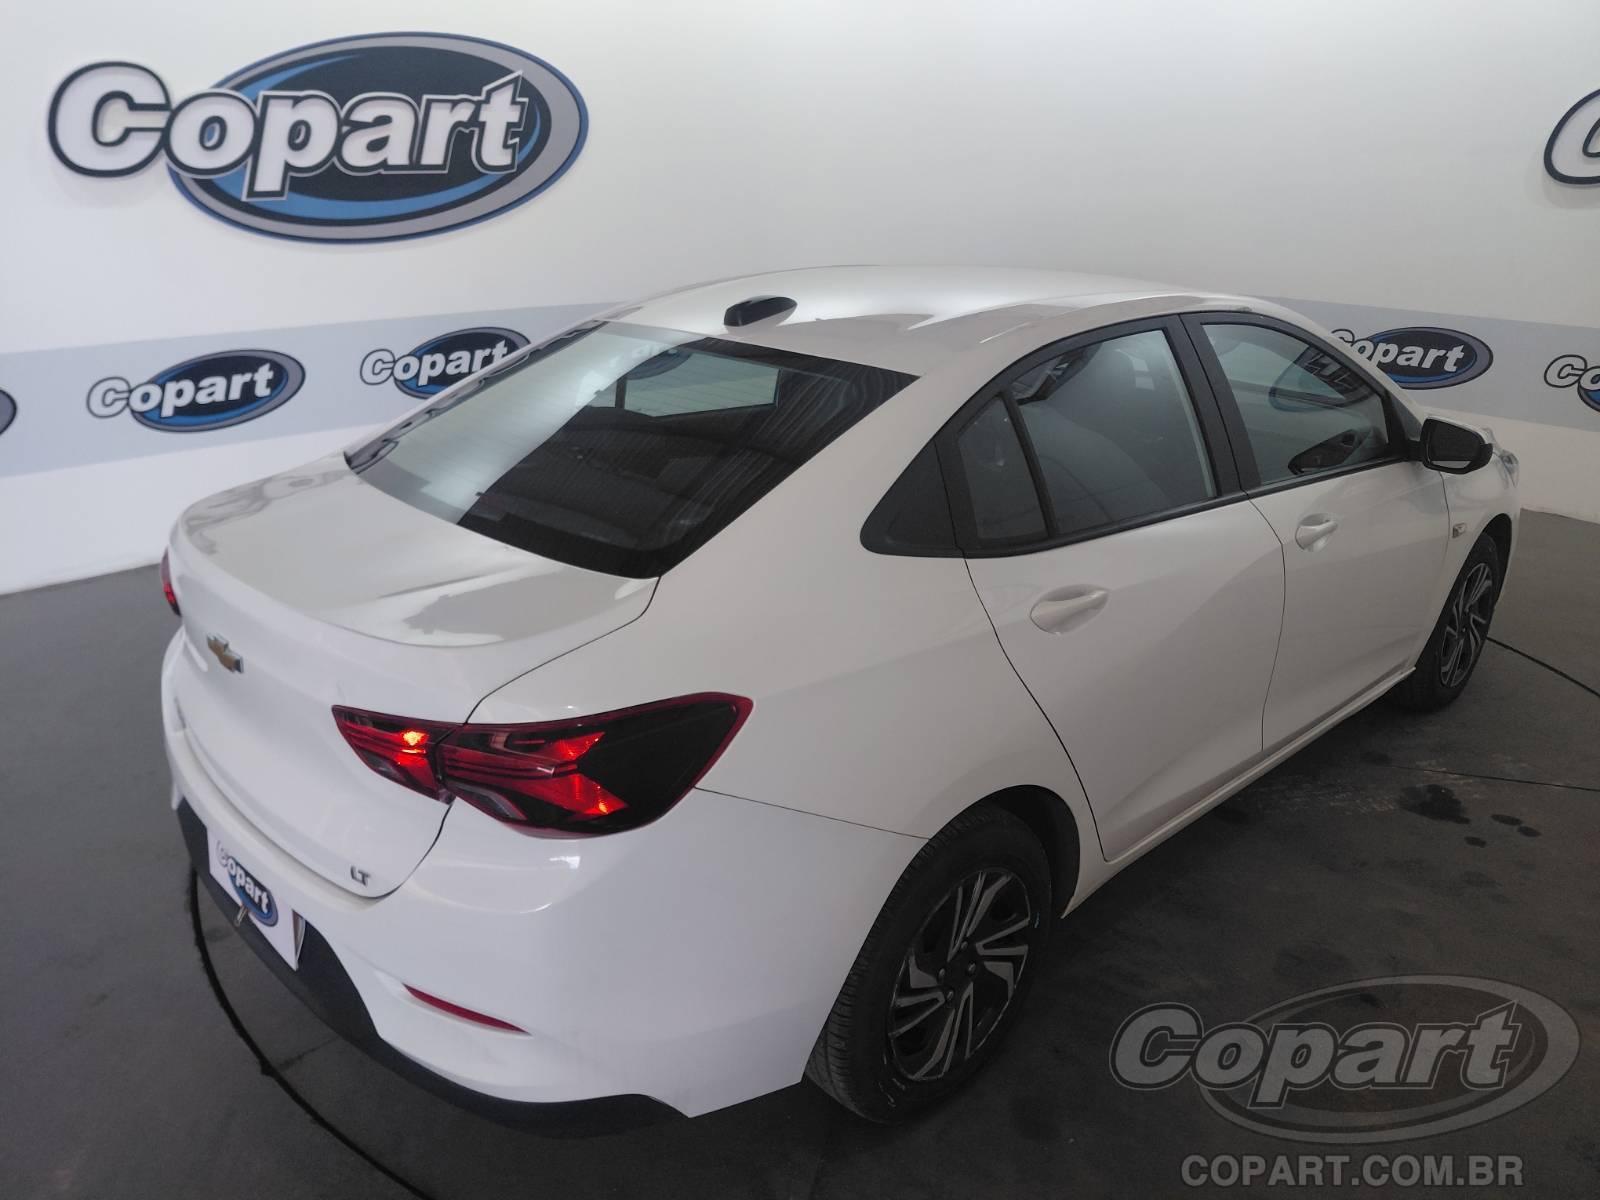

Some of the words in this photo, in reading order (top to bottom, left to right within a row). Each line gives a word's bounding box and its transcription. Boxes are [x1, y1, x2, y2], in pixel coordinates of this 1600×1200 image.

[49, 61, 529, 199] Copart
[87, 362, 273, 418] Copart
[350, 865, 370, 886] LT
